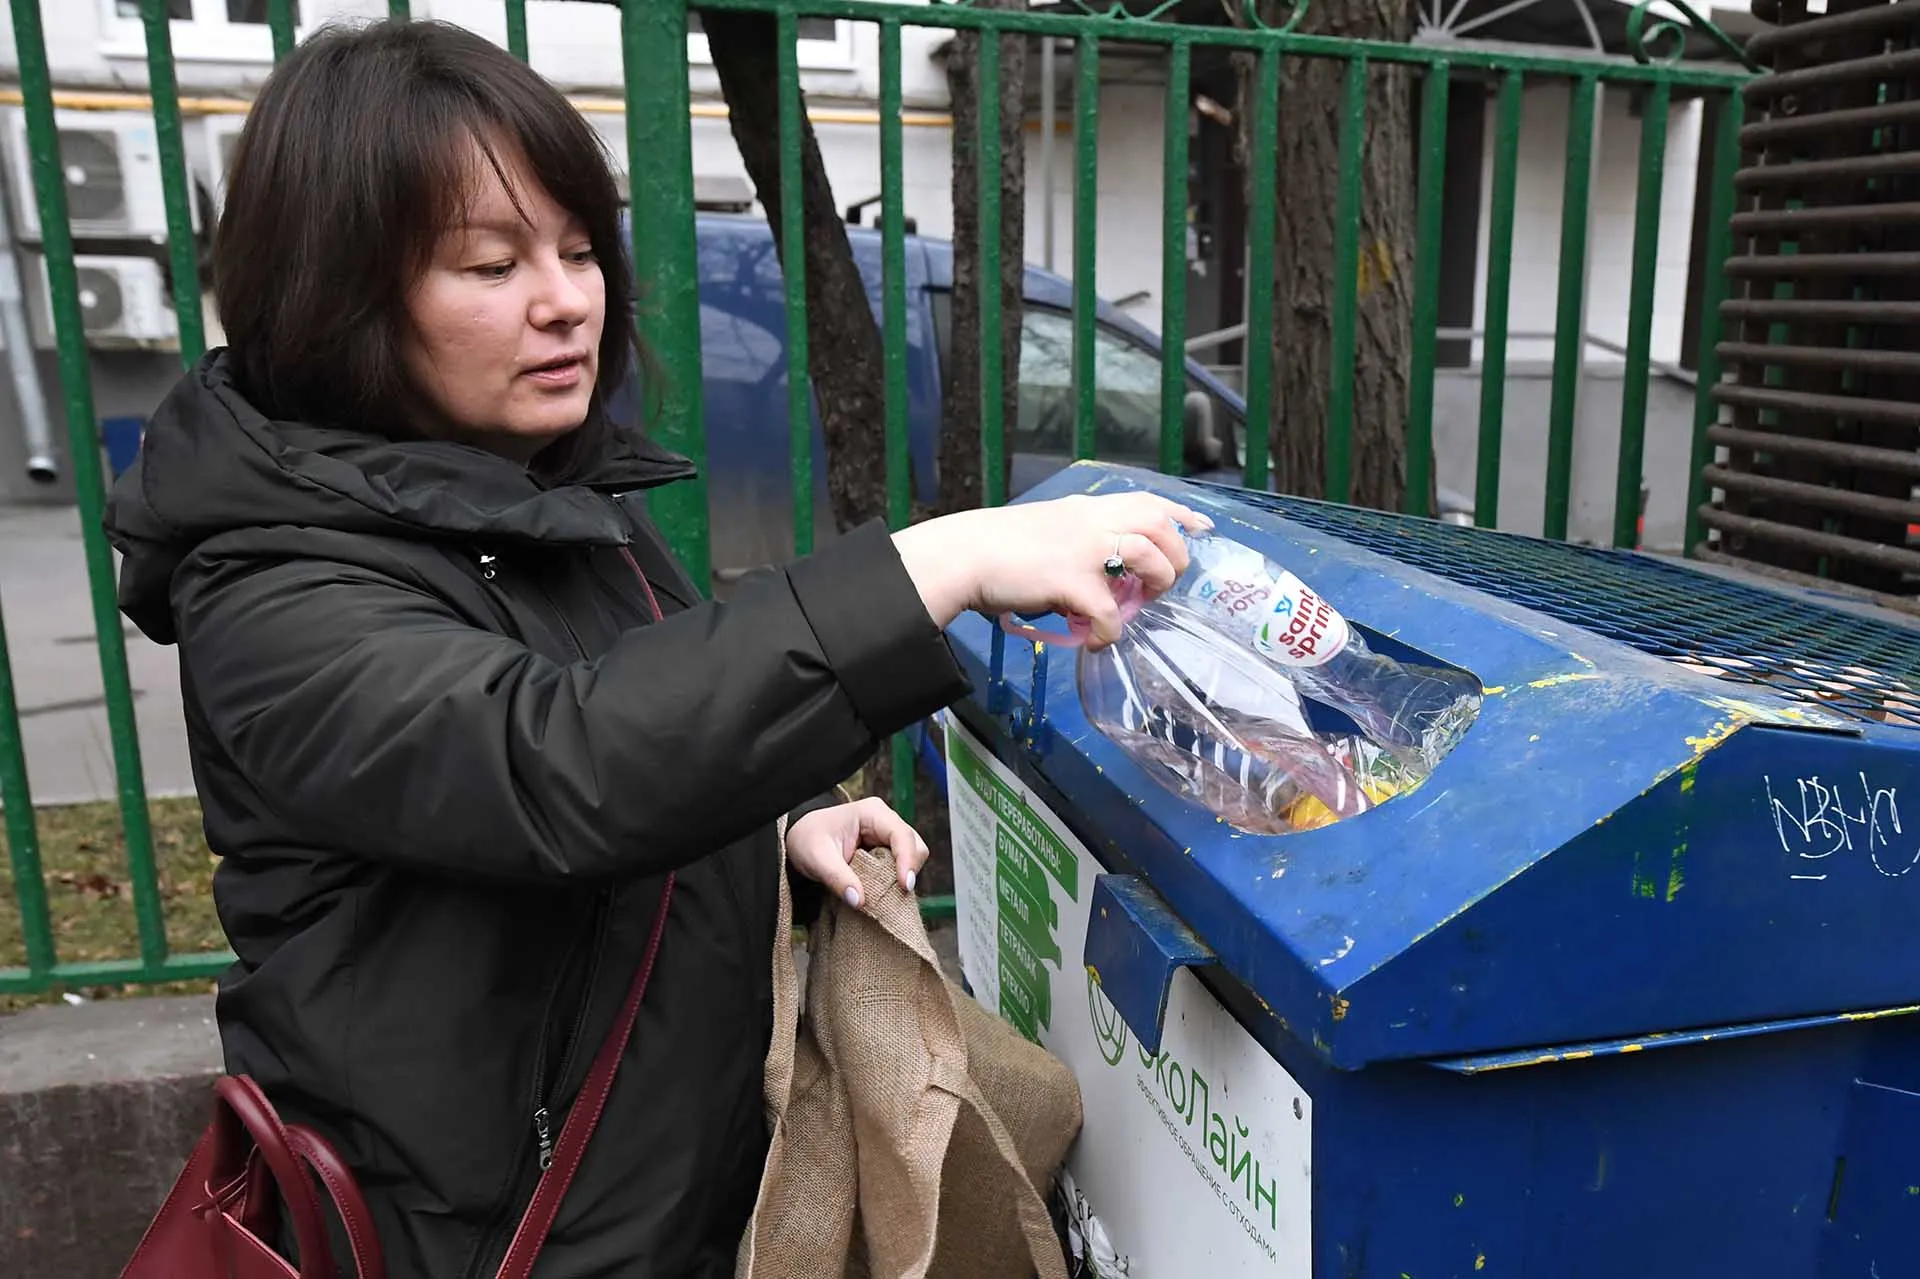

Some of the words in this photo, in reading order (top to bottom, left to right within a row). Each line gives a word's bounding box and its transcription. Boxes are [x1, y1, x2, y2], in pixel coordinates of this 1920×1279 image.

[1278, 588, 1315, 646] saint
[998, 791, 1061, 875] ПЕРЕРАБОТАНЫ:
[998, 830, 1030, 879] БУМАГА
[999, 874, 1030, 925] МЕТАЛЛ
[999, 918, 1038, 982] ТЕТРАПАК
[1001, 962, 1031, 1015] СТЕКЛО
[1136, 1073, 1179, 1142] ЭФФЕКТИВНОЕ
[1178, 1135, 1222, 1200] ОБРАЩЕНИЕ
[1222, 1191, 1229, 1207] С
[1228, 1200, 1277, 1265] ОТХОДАМИ
